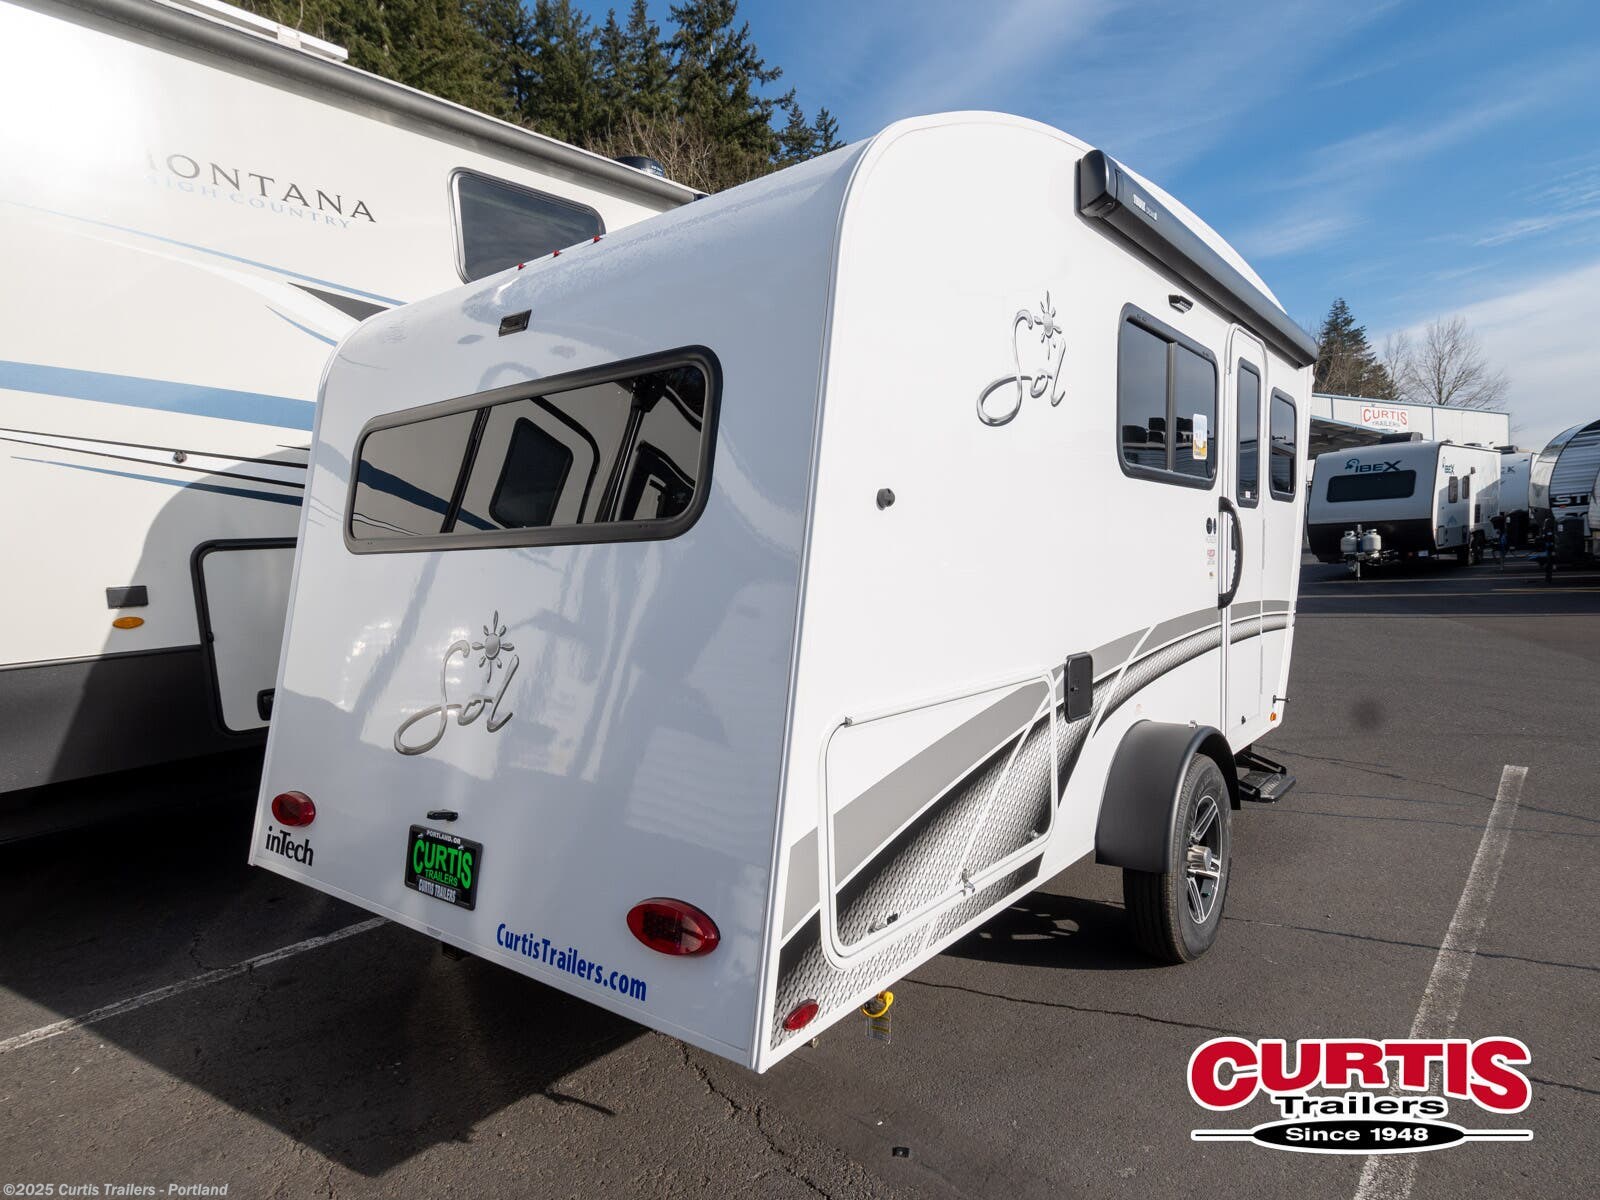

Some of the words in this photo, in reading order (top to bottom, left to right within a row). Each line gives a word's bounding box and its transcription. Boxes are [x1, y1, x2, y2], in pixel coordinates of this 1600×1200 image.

[229, 192, 351, 229] COUNTRY
[976, 309, 1067, 427] Sol
[1363, 408, 1408, 426] CURTIS
[394, 639, 520, 756] Sol
[265, 825, 315, 867] inTech
[413, 839, 473, 890] CURTIS
[418, 879, 435, 897] CURTIS
[434, 885, 457, 904] TRAILERS
[424, 869, 459, 887] TRAILERS
[496, 923, 648, 1002] CurtisTrailers.com
